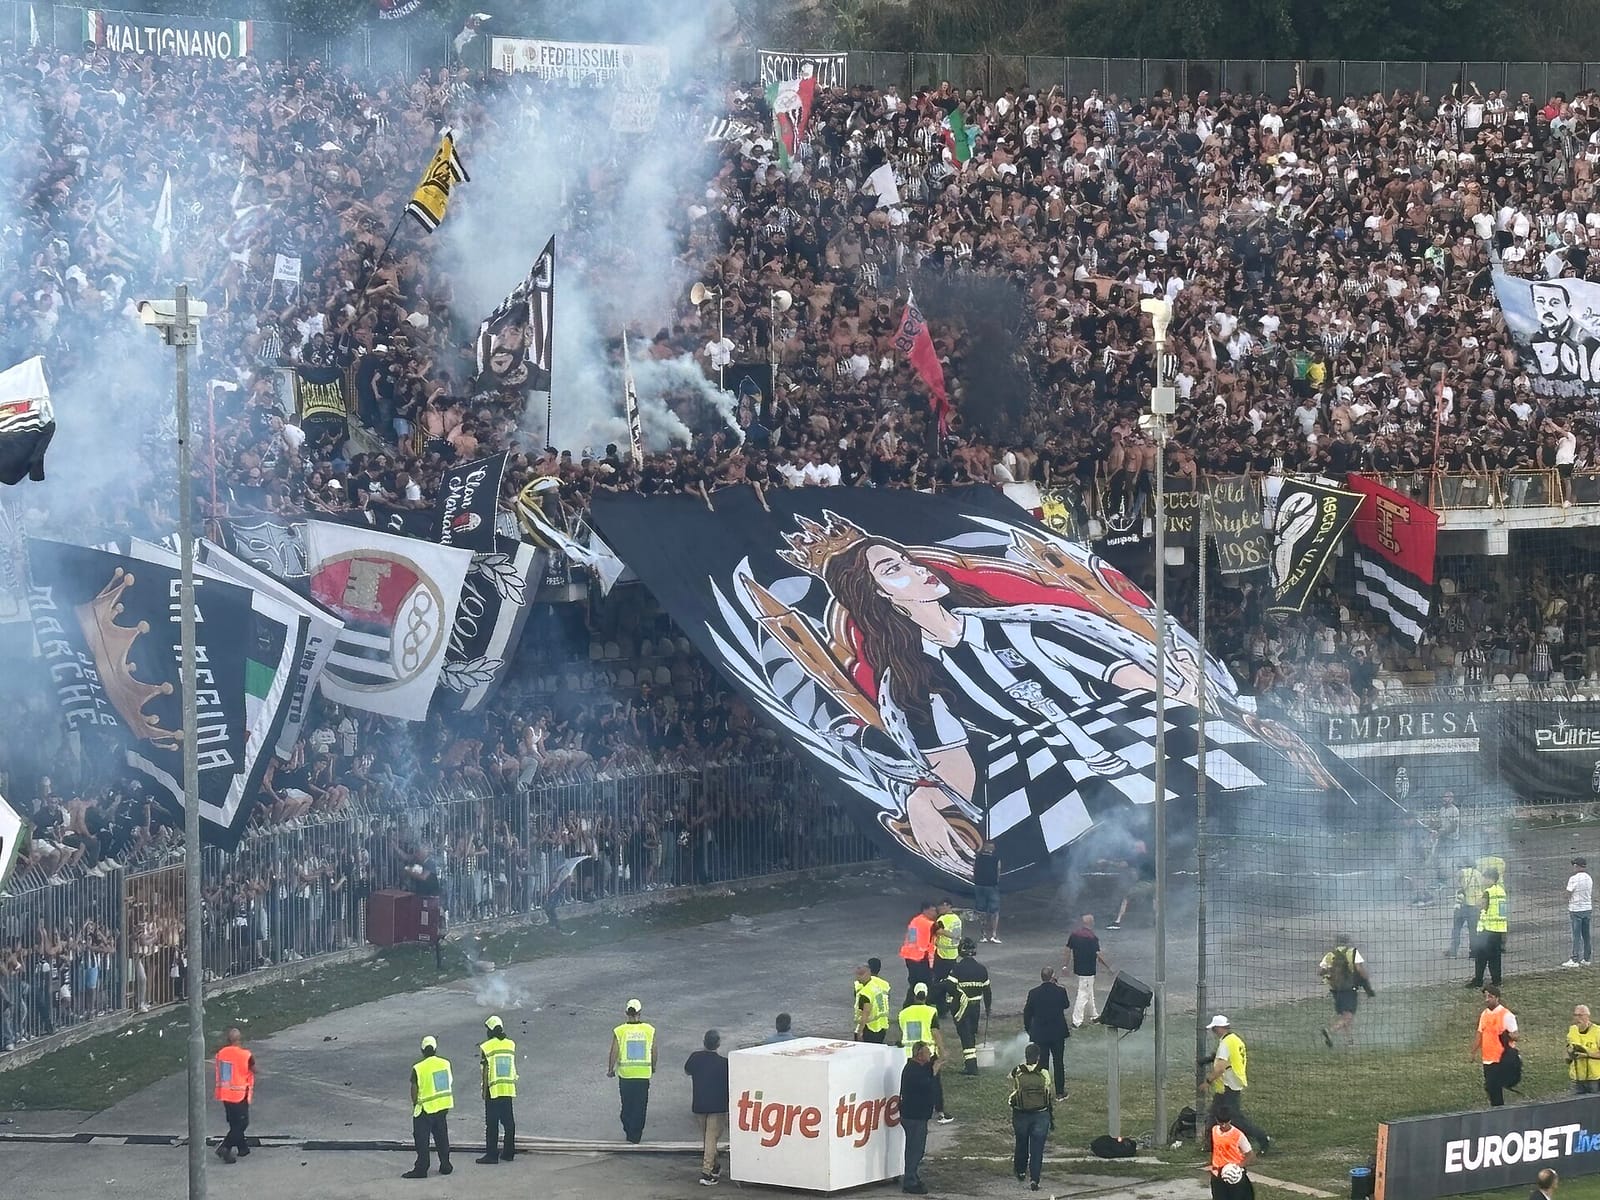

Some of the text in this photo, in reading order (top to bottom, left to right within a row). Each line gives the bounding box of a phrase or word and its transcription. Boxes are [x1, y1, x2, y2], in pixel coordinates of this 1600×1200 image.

[105, 24, 232, 60] MALTIGNANO
[540, 46, 619, 68] FEDELISSIMI
[1213, 482, 1246, 504] Old
[1214, 508, 1261, 538] Style
[1312, 496, 1338, 544] ASCOLI
[1221, 535, 1271, 567] 1983
[1328, 711, 1479, 741] EMPRESA
[737, 1090, 822, 1148] tigre
[835, 1092, 901, 1148] tigre
